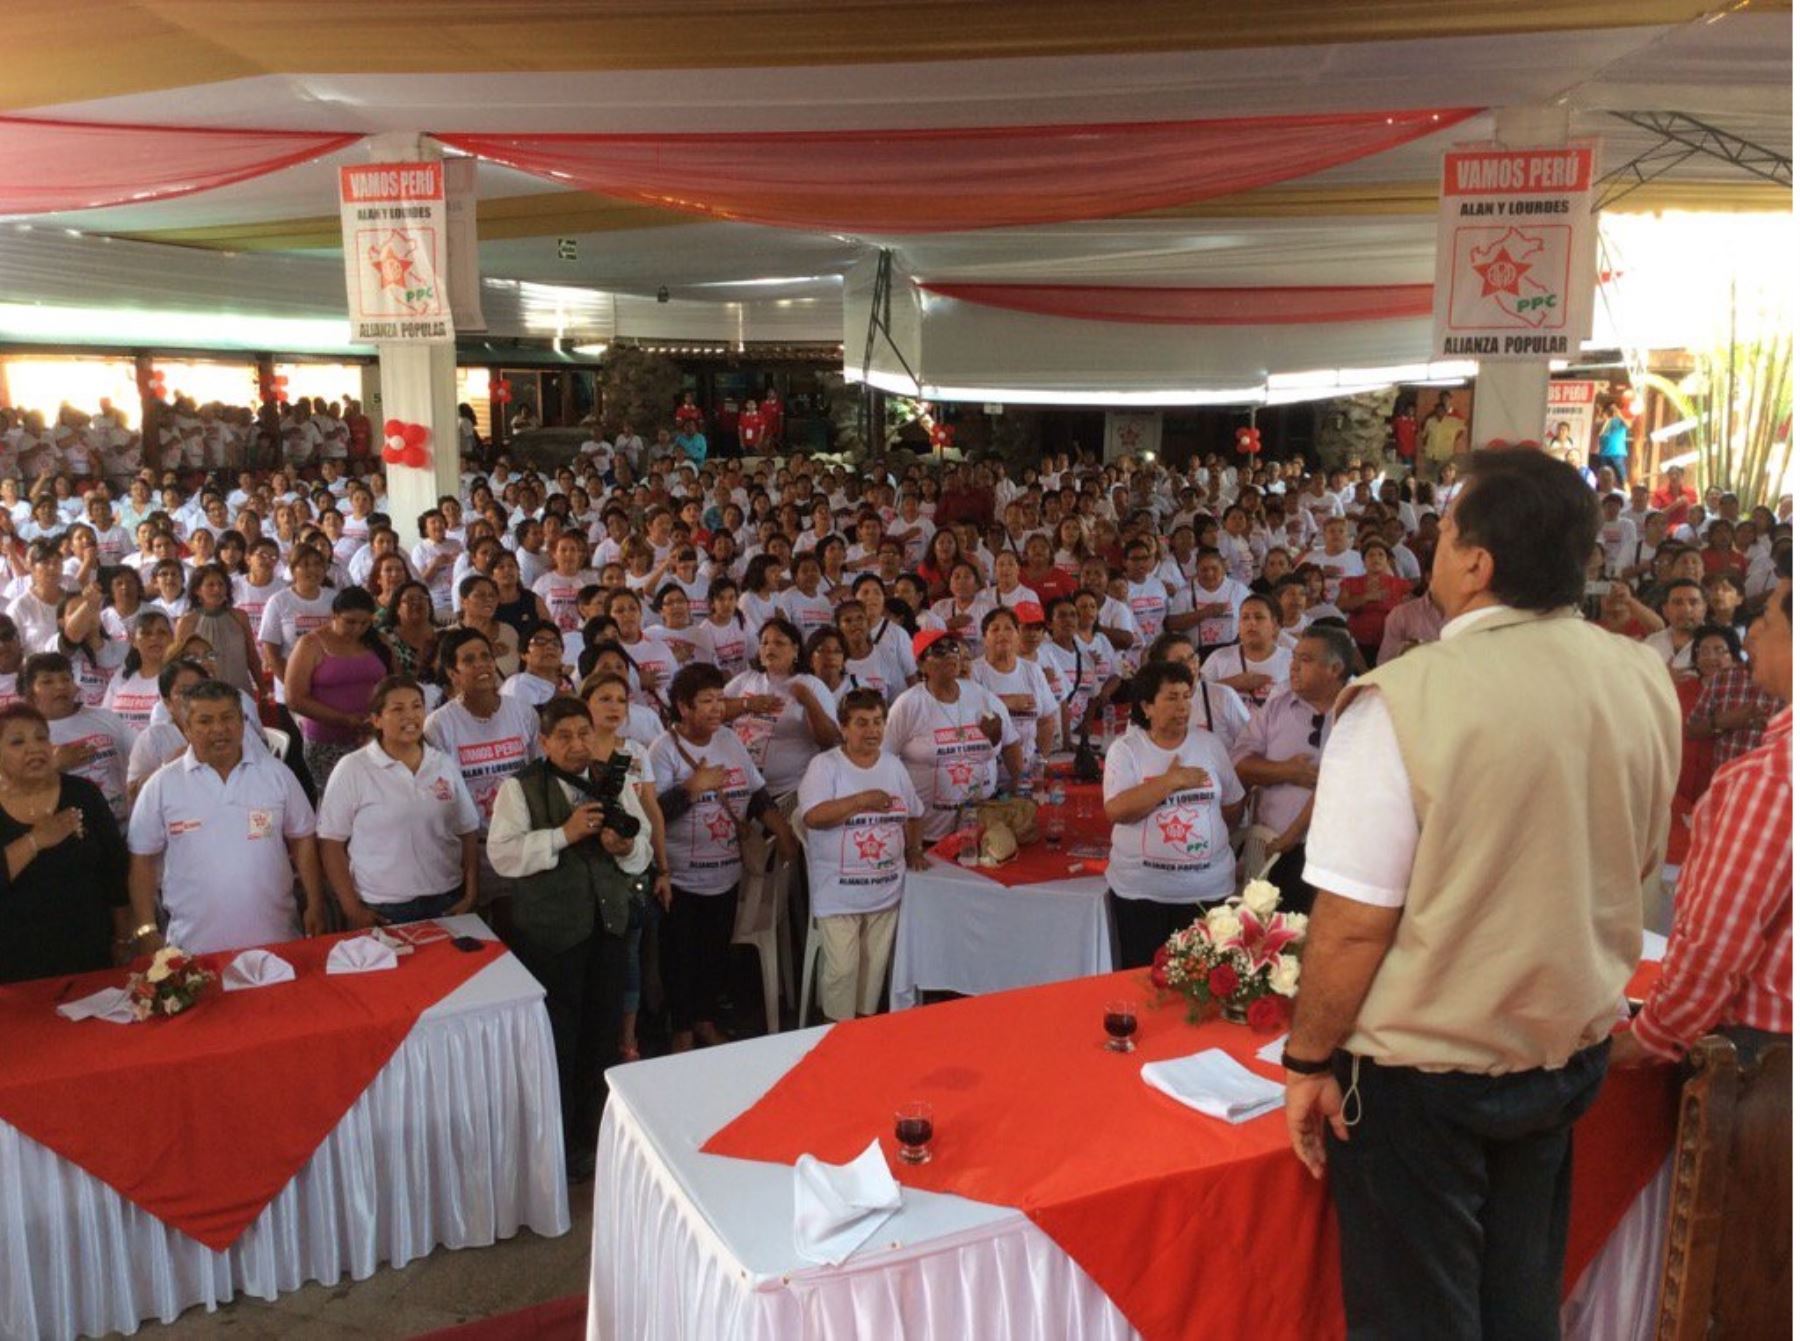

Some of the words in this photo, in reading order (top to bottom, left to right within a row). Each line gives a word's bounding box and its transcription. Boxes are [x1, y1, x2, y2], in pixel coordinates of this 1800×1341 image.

[1457, 159, 1525, 190] VAMOS
[1529, 152, 1581, 187] PERÚ
[350, 171, 399, 197] VAMOS
[401, 165, 434, 196] PERÚ
[1460, 203, 1494, 216] ALAN
[1497, 202, 1507, 215] Y
[1509, 200, 1569, 215] LOURDES
[1516, 294, 1557, 312] PPC
[401, 321, 447, 337] POPULAR
[1444, 336, 1498, 355] ALIANZA
[1505, 335, 1567, 353] POPULAR
